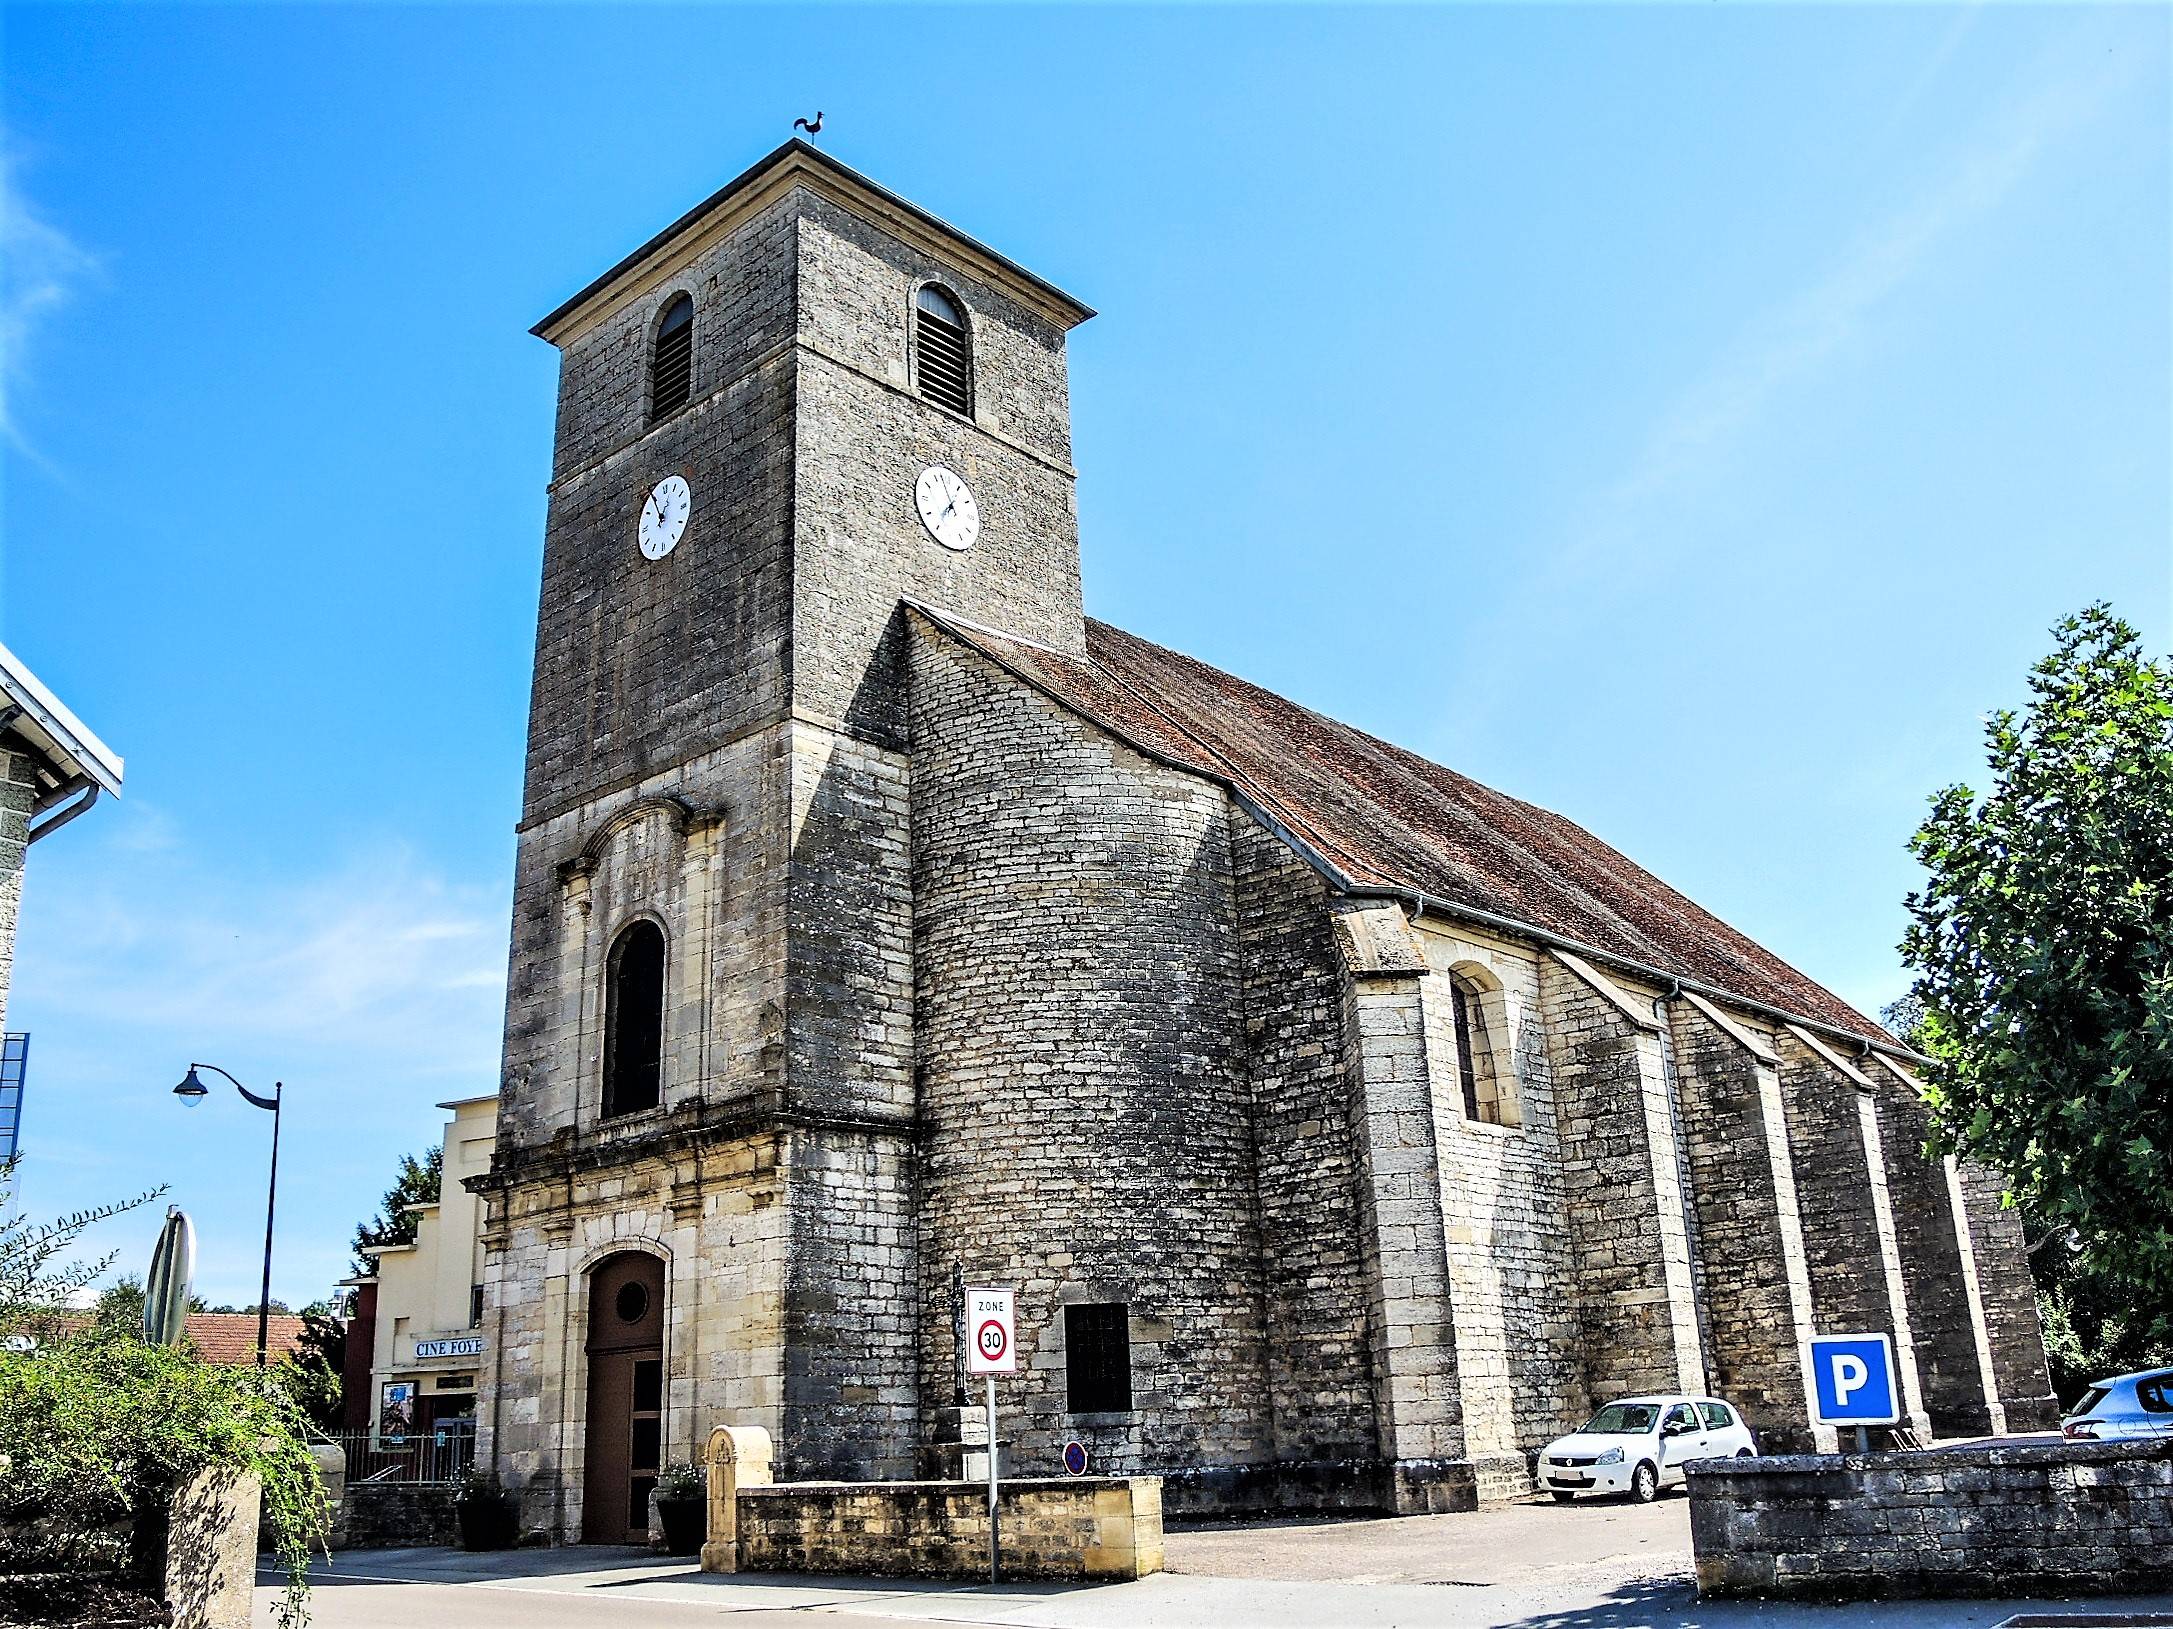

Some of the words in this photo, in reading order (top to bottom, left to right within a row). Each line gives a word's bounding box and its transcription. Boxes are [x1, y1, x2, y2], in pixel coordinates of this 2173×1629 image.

[978, 1301, 1004, 1311] ZONE
[984, 1332, 1001, 1348] 30
[1831, 1354, 1868, 1406] P
